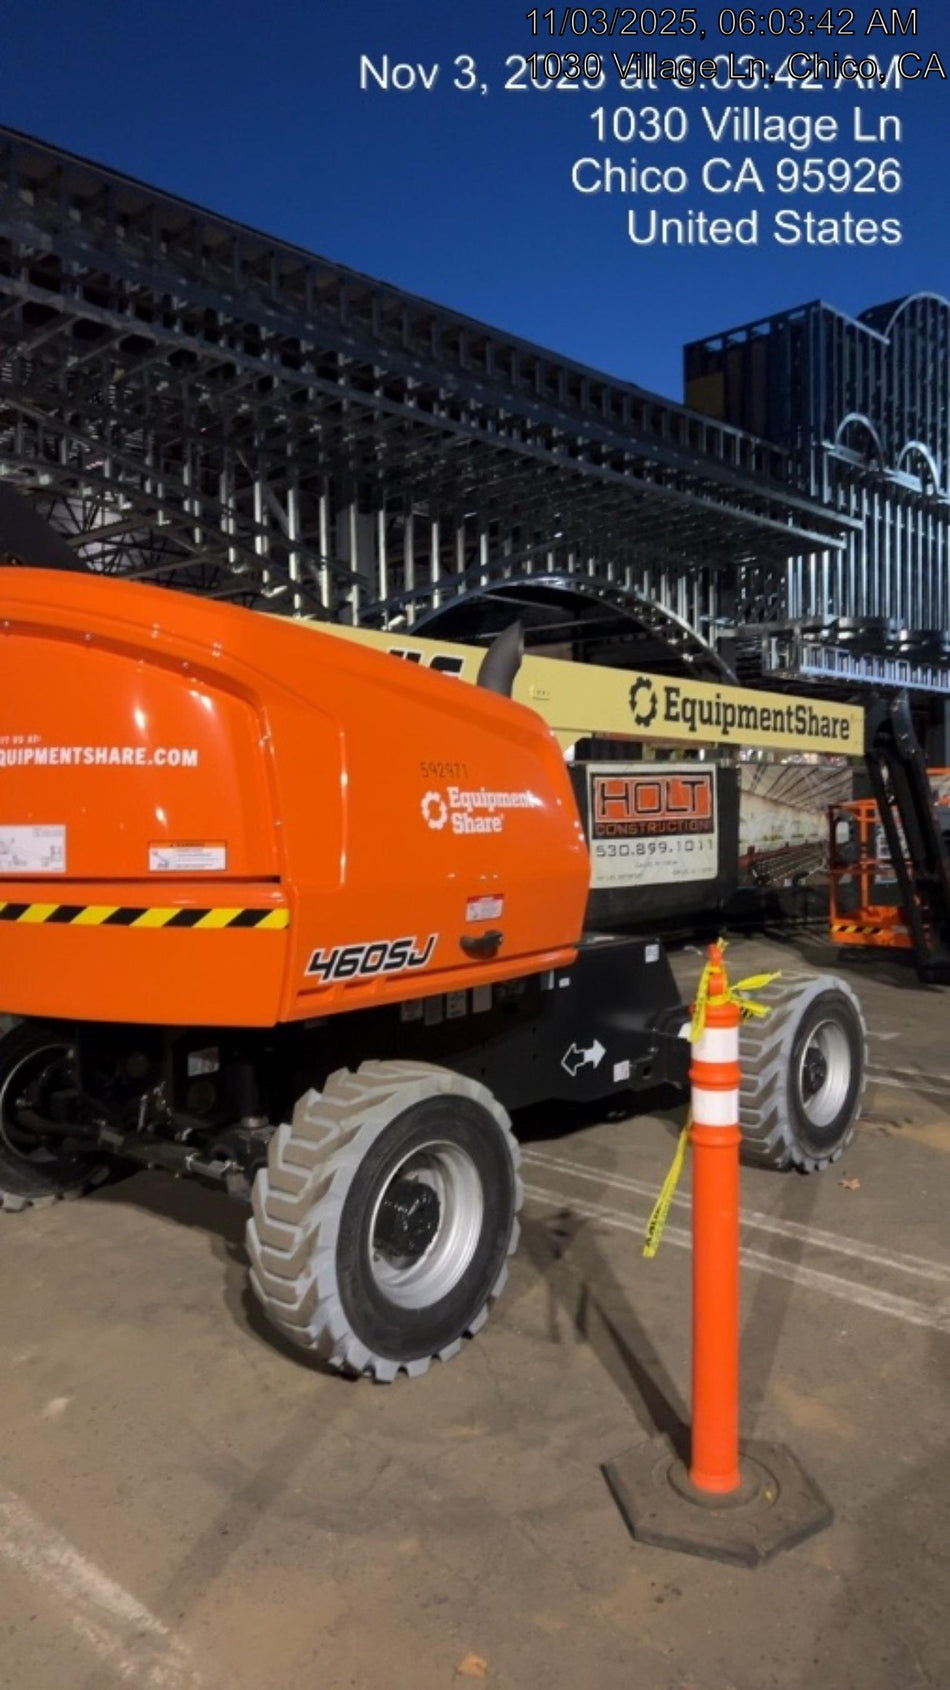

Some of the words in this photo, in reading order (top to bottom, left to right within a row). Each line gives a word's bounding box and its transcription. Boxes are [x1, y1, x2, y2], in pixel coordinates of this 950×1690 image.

[664, 685, 850, 740] EquipmentShare
[600, 780, 705, 816] HOLT
[451, 811, 503, 834] Share
[596, 820, 711, 836] CONSTRUCTION
[596, 839, 713, 858] 530.899.1011
[305, 933, 438, 984] 460SJ
